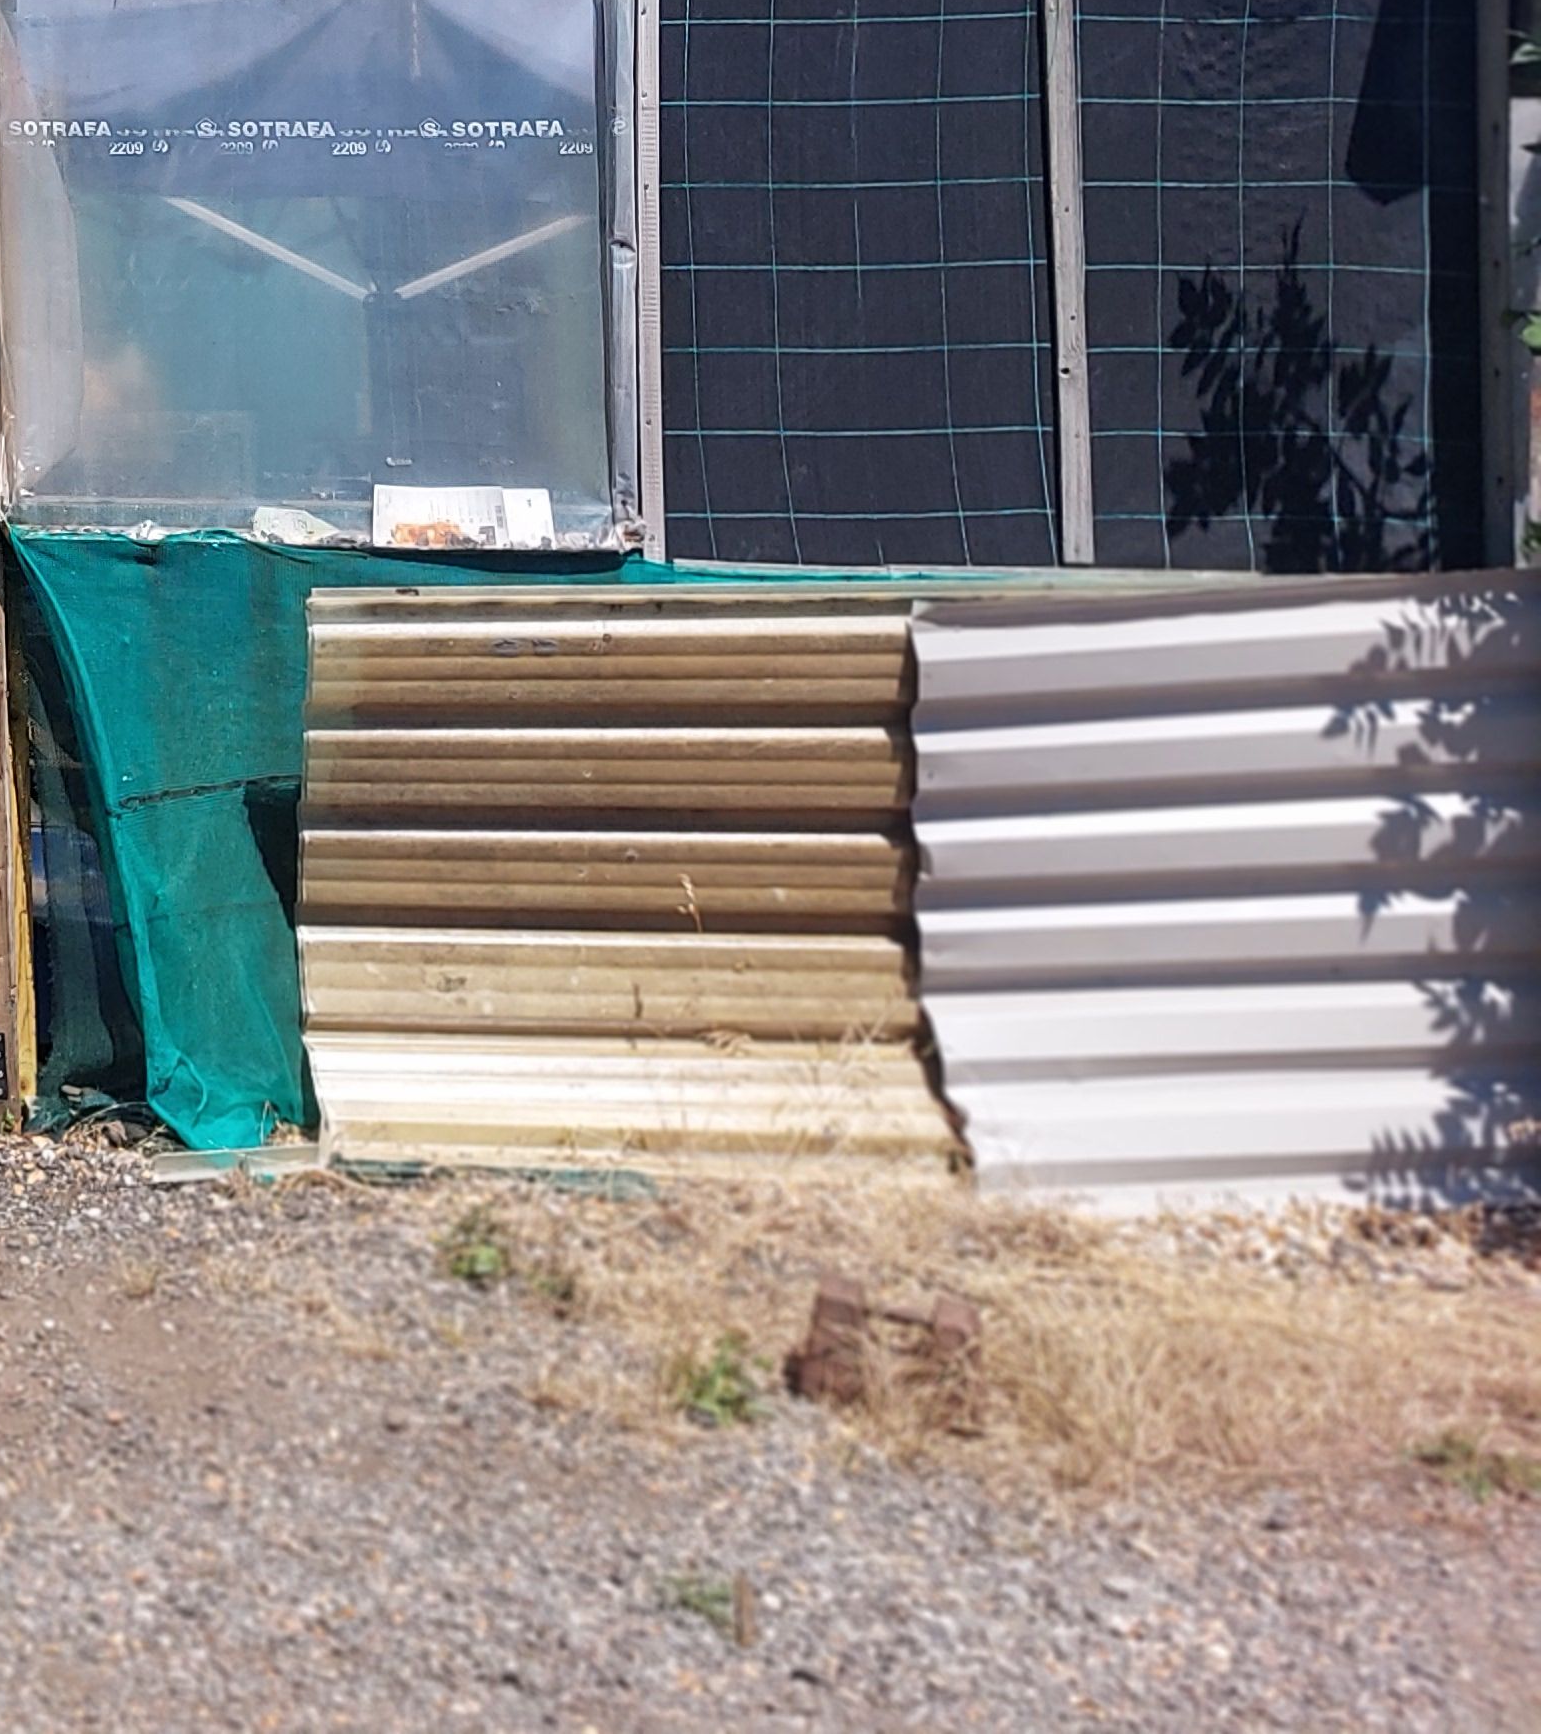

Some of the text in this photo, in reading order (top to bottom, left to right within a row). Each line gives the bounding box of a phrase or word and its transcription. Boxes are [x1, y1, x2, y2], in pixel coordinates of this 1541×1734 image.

[8, 120, 112, 137] SOTRAFA
[227, 120, 336, 138] SOTRAFA
[451, 120, 564, 138] SOTRAFA
[108, 141, 144, 156] 2209
[331, 141, 367, 156] 2209
